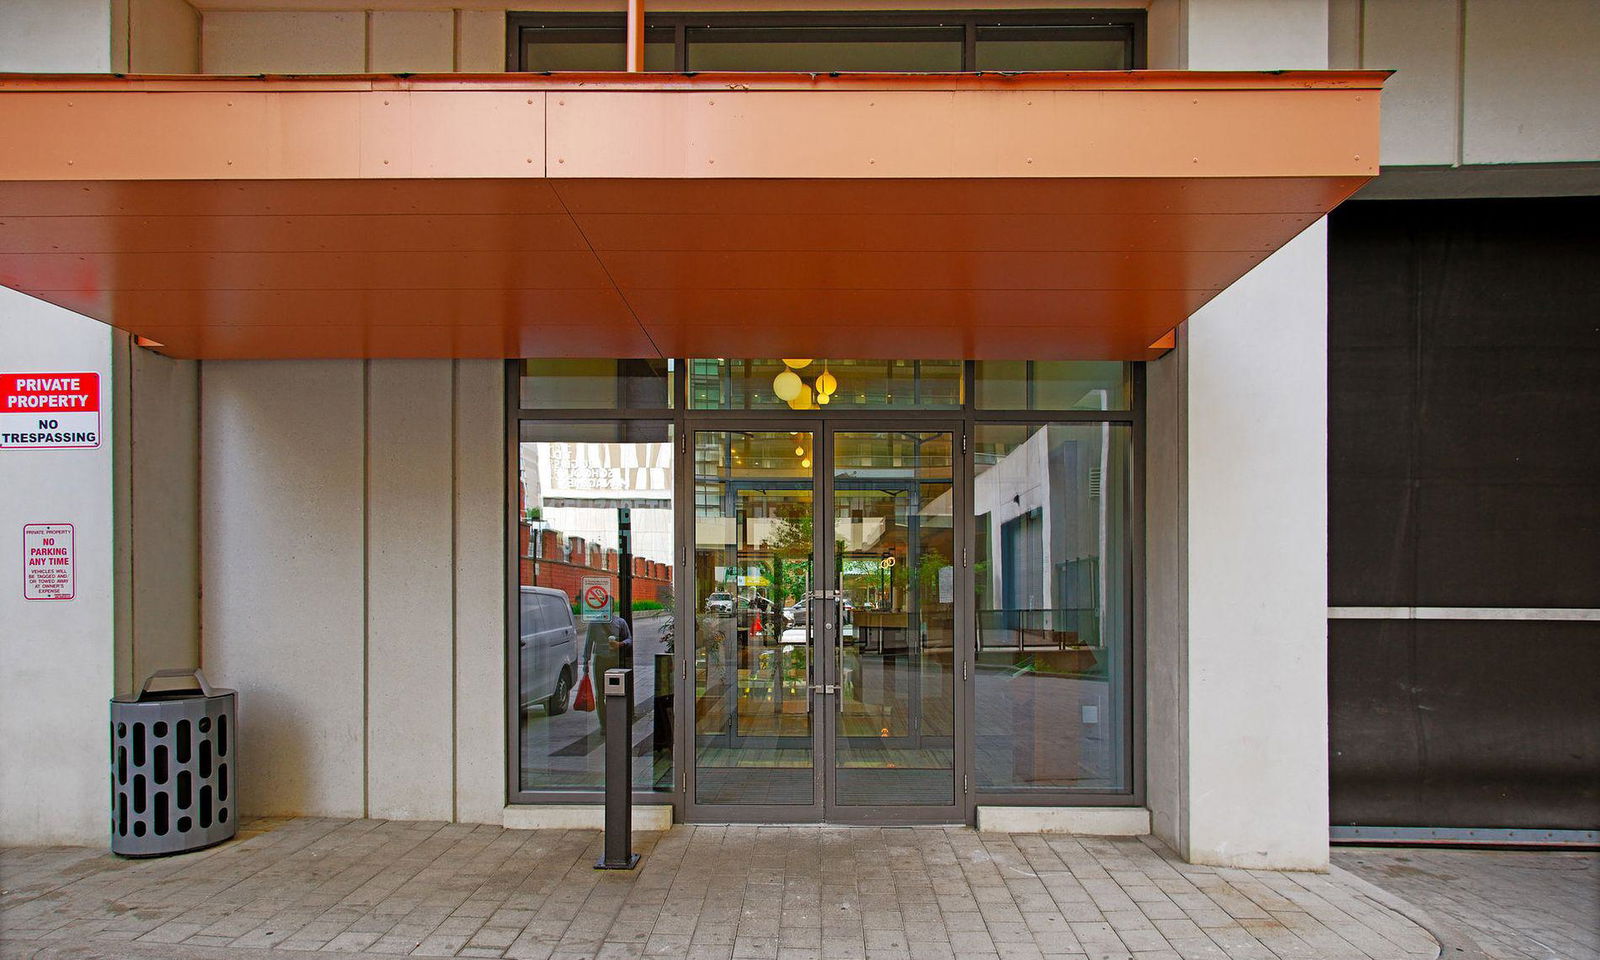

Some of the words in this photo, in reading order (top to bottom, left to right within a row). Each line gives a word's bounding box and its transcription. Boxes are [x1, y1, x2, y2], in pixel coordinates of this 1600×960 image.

[16, 378, 81, 391] PRIVATE
[8, 395, 89, 408] PROPERTY
[39, 419, 58, 430] NO
[2, 432, 96, 443] TRESPASSING
[43, 538, 55, 546] NO
[30, 548, 67, 556] PARKING
[29, 558, 46, 566] ANY
[49, 558, 69, 566] TIME
